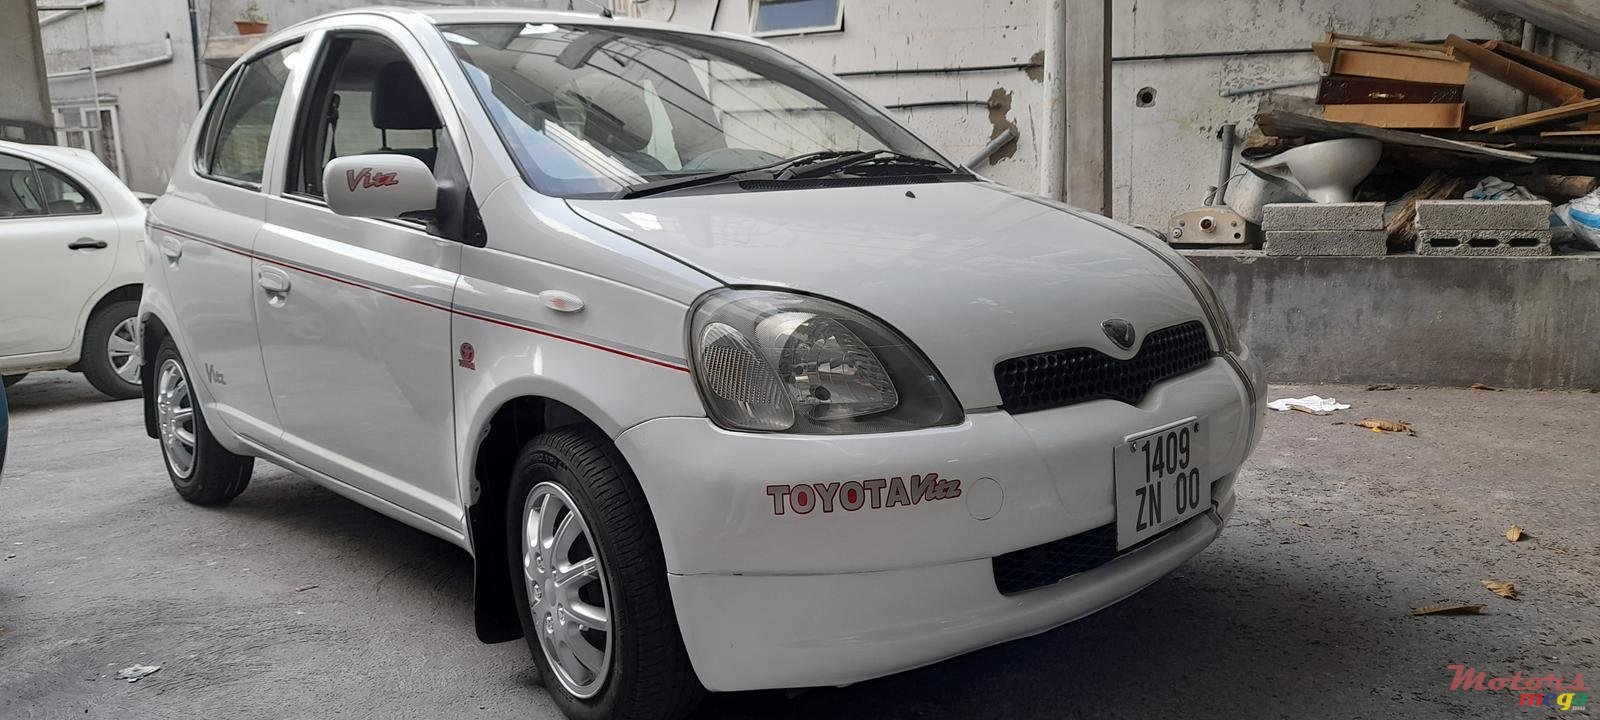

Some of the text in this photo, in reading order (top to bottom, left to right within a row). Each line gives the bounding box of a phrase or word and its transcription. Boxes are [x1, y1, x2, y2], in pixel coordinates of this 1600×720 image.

[346, 167, 399, 192] Vitz
[1141, 427, 1190, 483] 1409
[1135, 467, 1200, 532] ZN 00
